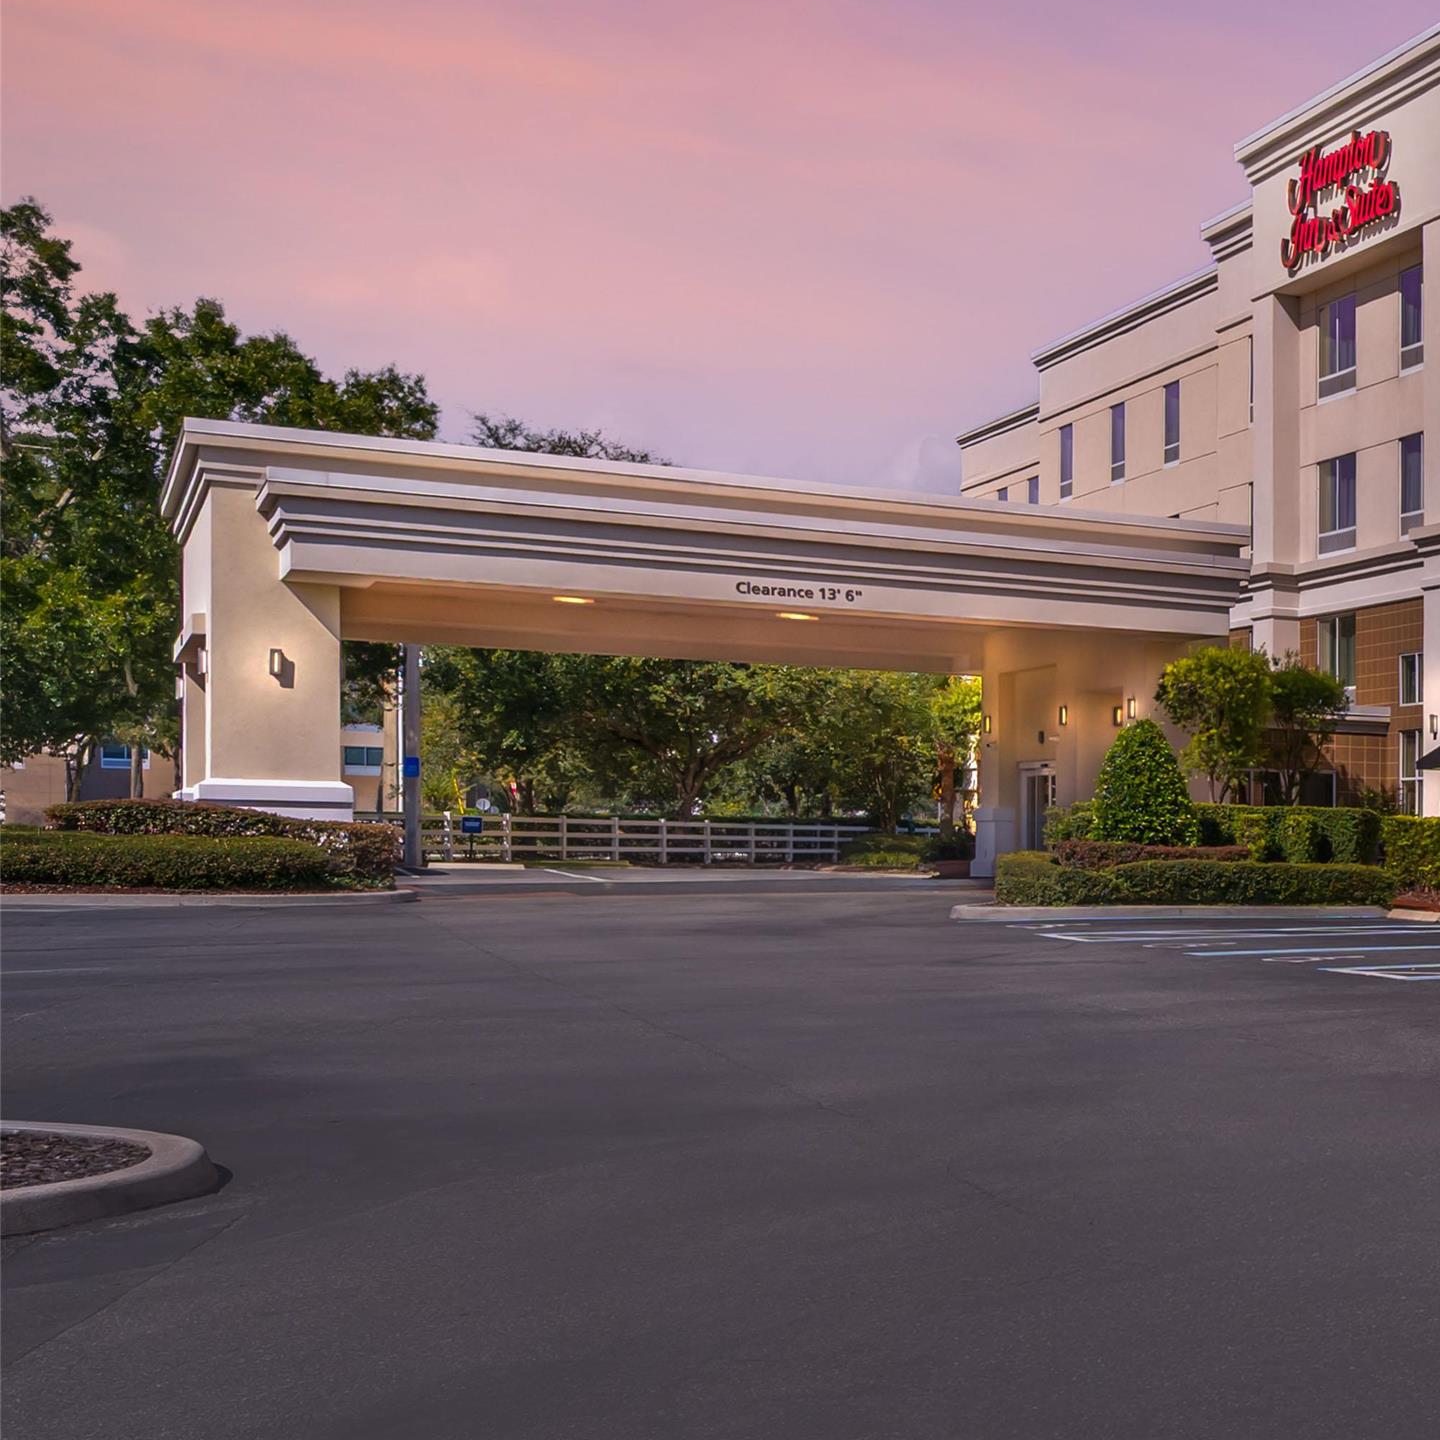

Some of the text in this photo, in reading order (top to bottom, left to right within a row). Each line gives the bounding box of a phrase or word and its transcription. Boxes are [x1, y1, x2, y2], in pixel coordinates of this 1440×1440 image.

[1288, 130, 1391, 215] Hampton
[1281, 213, 1329, 268] Inn
[1339, 180, 1399, 235] Suites
[735, 581, 862, 602] Clearance 13' 6"
